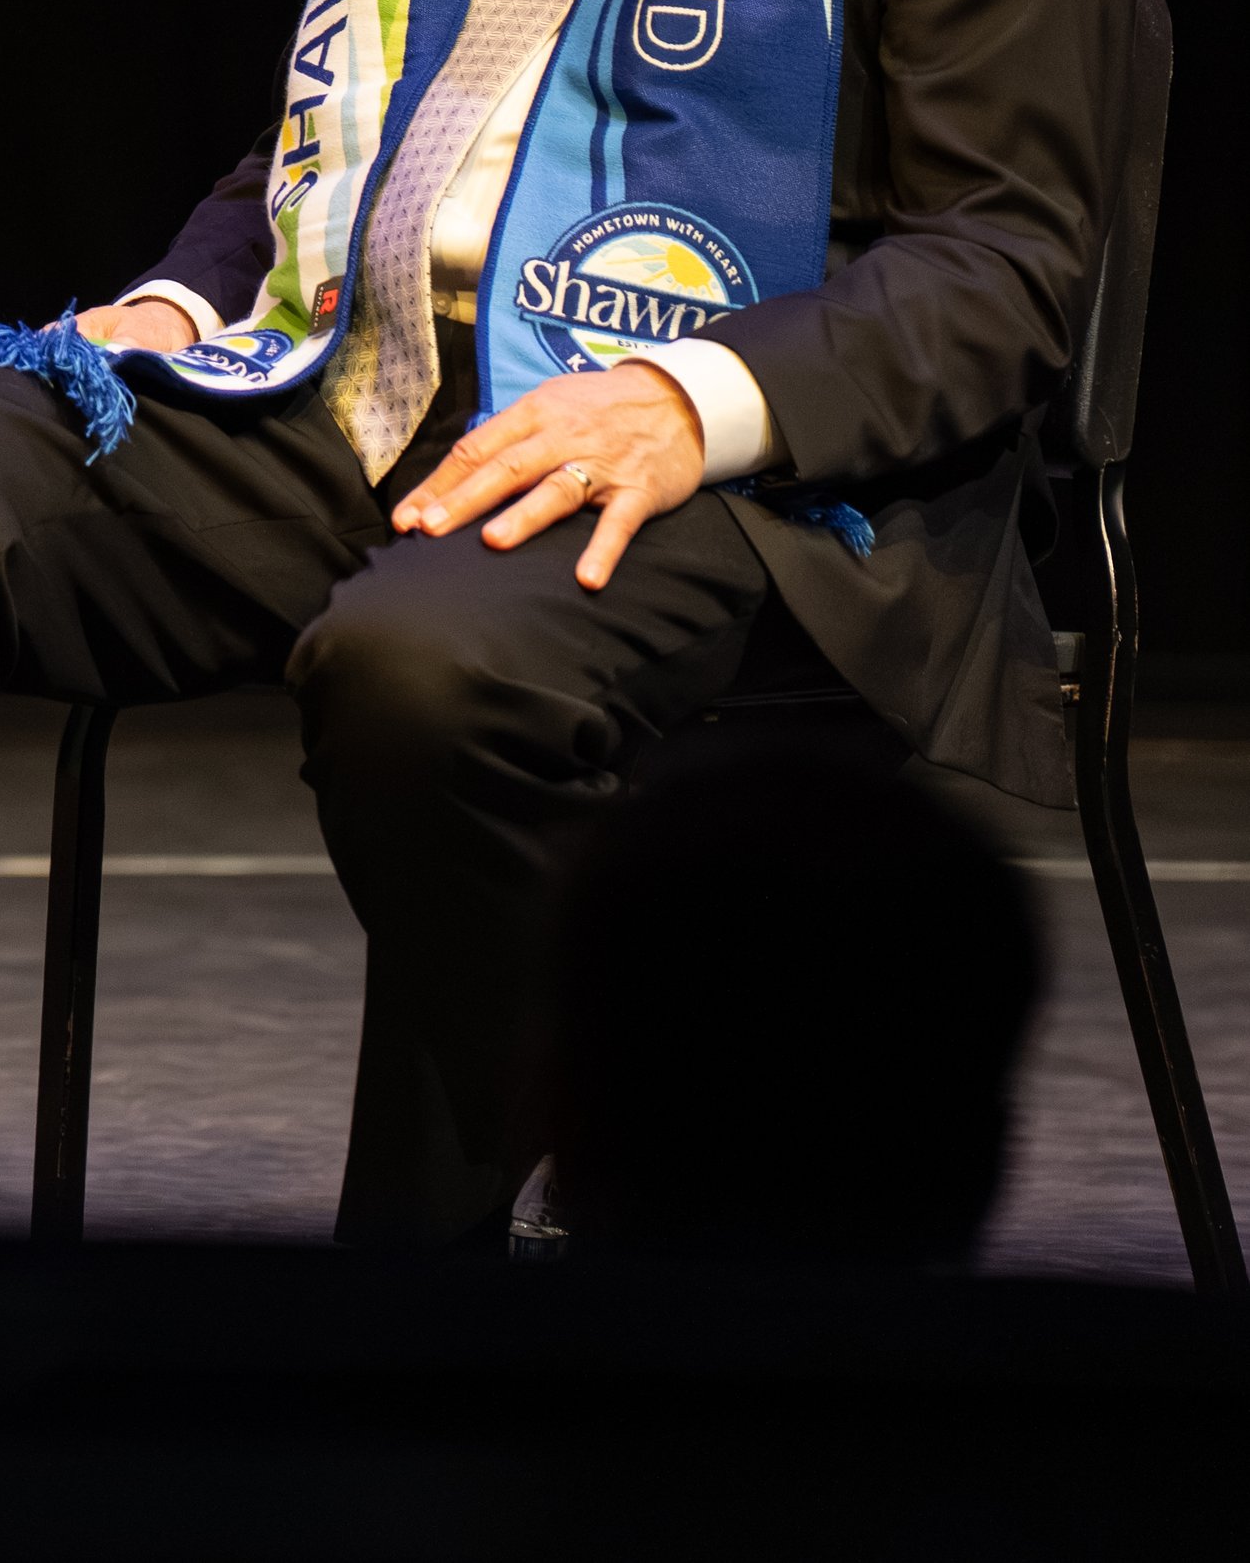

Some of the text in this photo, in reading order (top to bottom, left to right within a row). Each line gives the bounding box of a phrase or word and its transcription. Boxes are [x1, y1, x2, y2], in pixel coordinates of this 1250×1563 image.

[572, 213, 743, 286] HOMETOWN WITH HEART
[516, 258, 731, 340] Shawn
